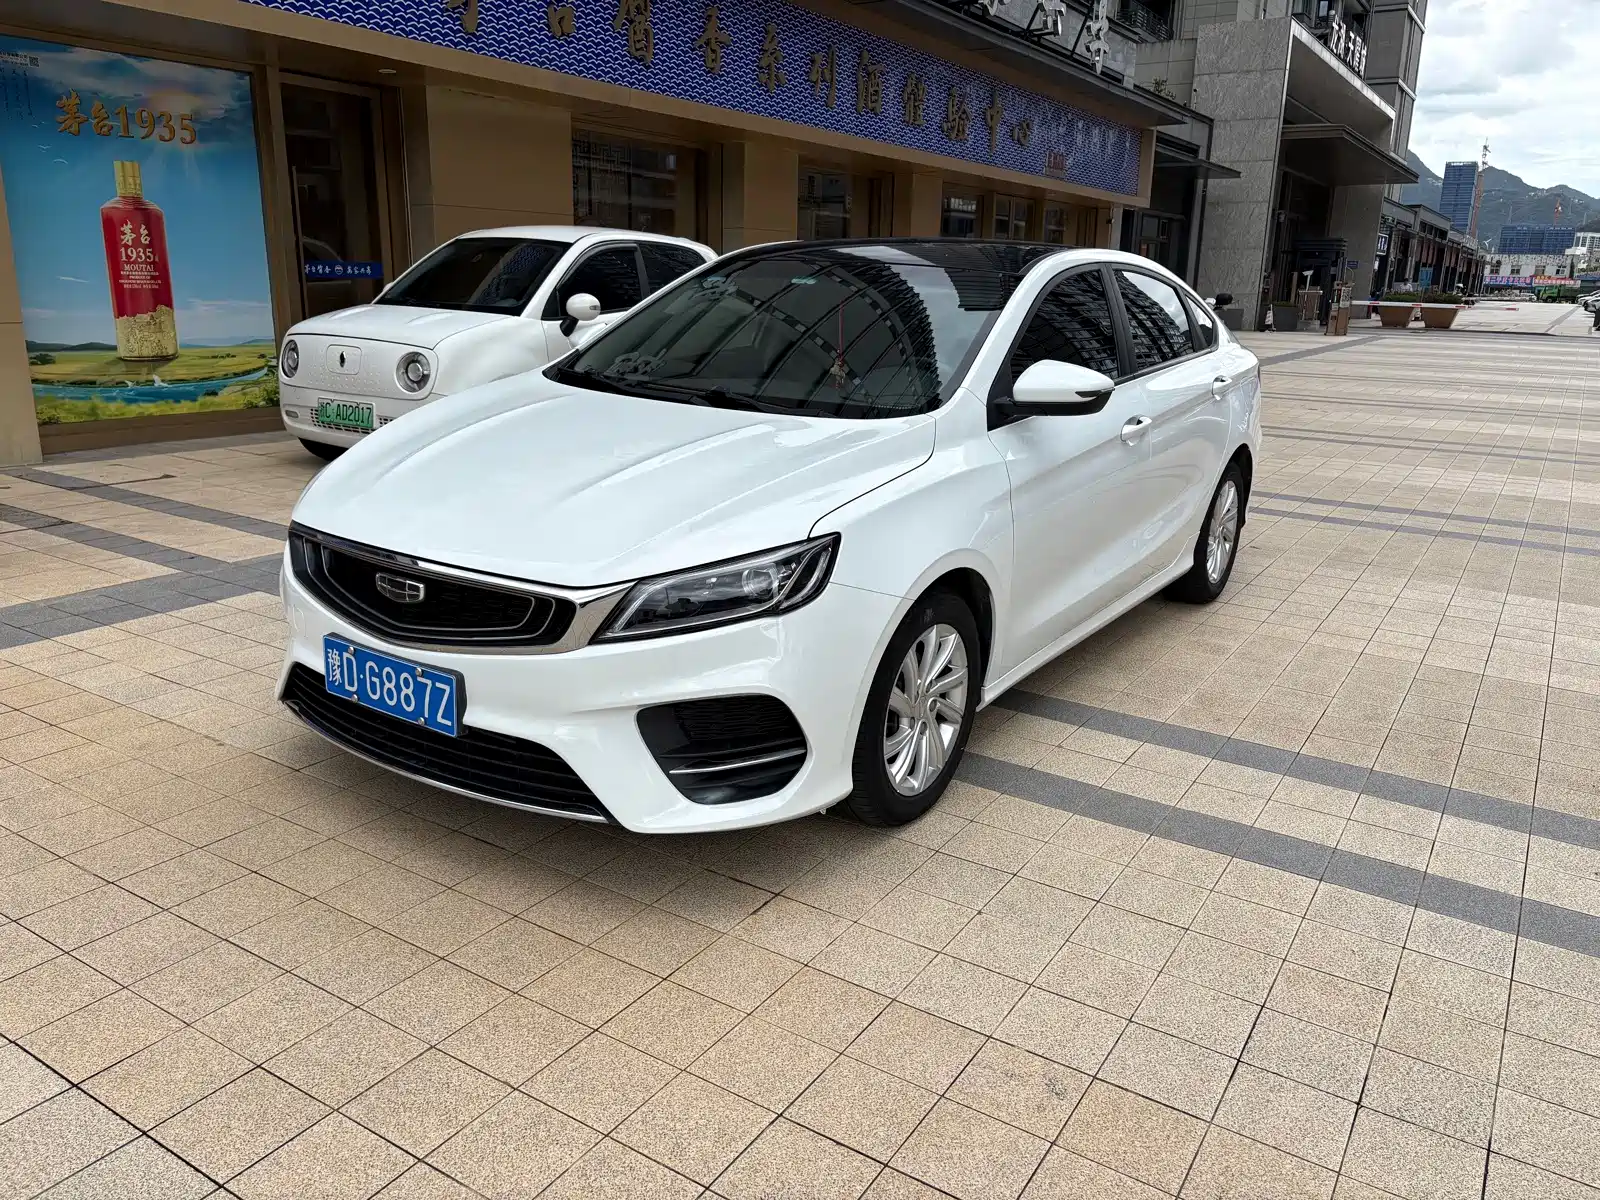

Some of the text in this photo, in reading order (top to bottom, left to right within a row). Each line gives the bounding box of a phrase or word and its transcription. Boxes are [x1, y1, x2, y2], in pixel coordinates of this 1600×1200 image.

[56, 88, 197, 145] 茅台1935
[120, 219, 151, 246] 茅台
[119, 247, 153, 262] 1935
[326, 648, 452, 726] 豫D·G887Z
